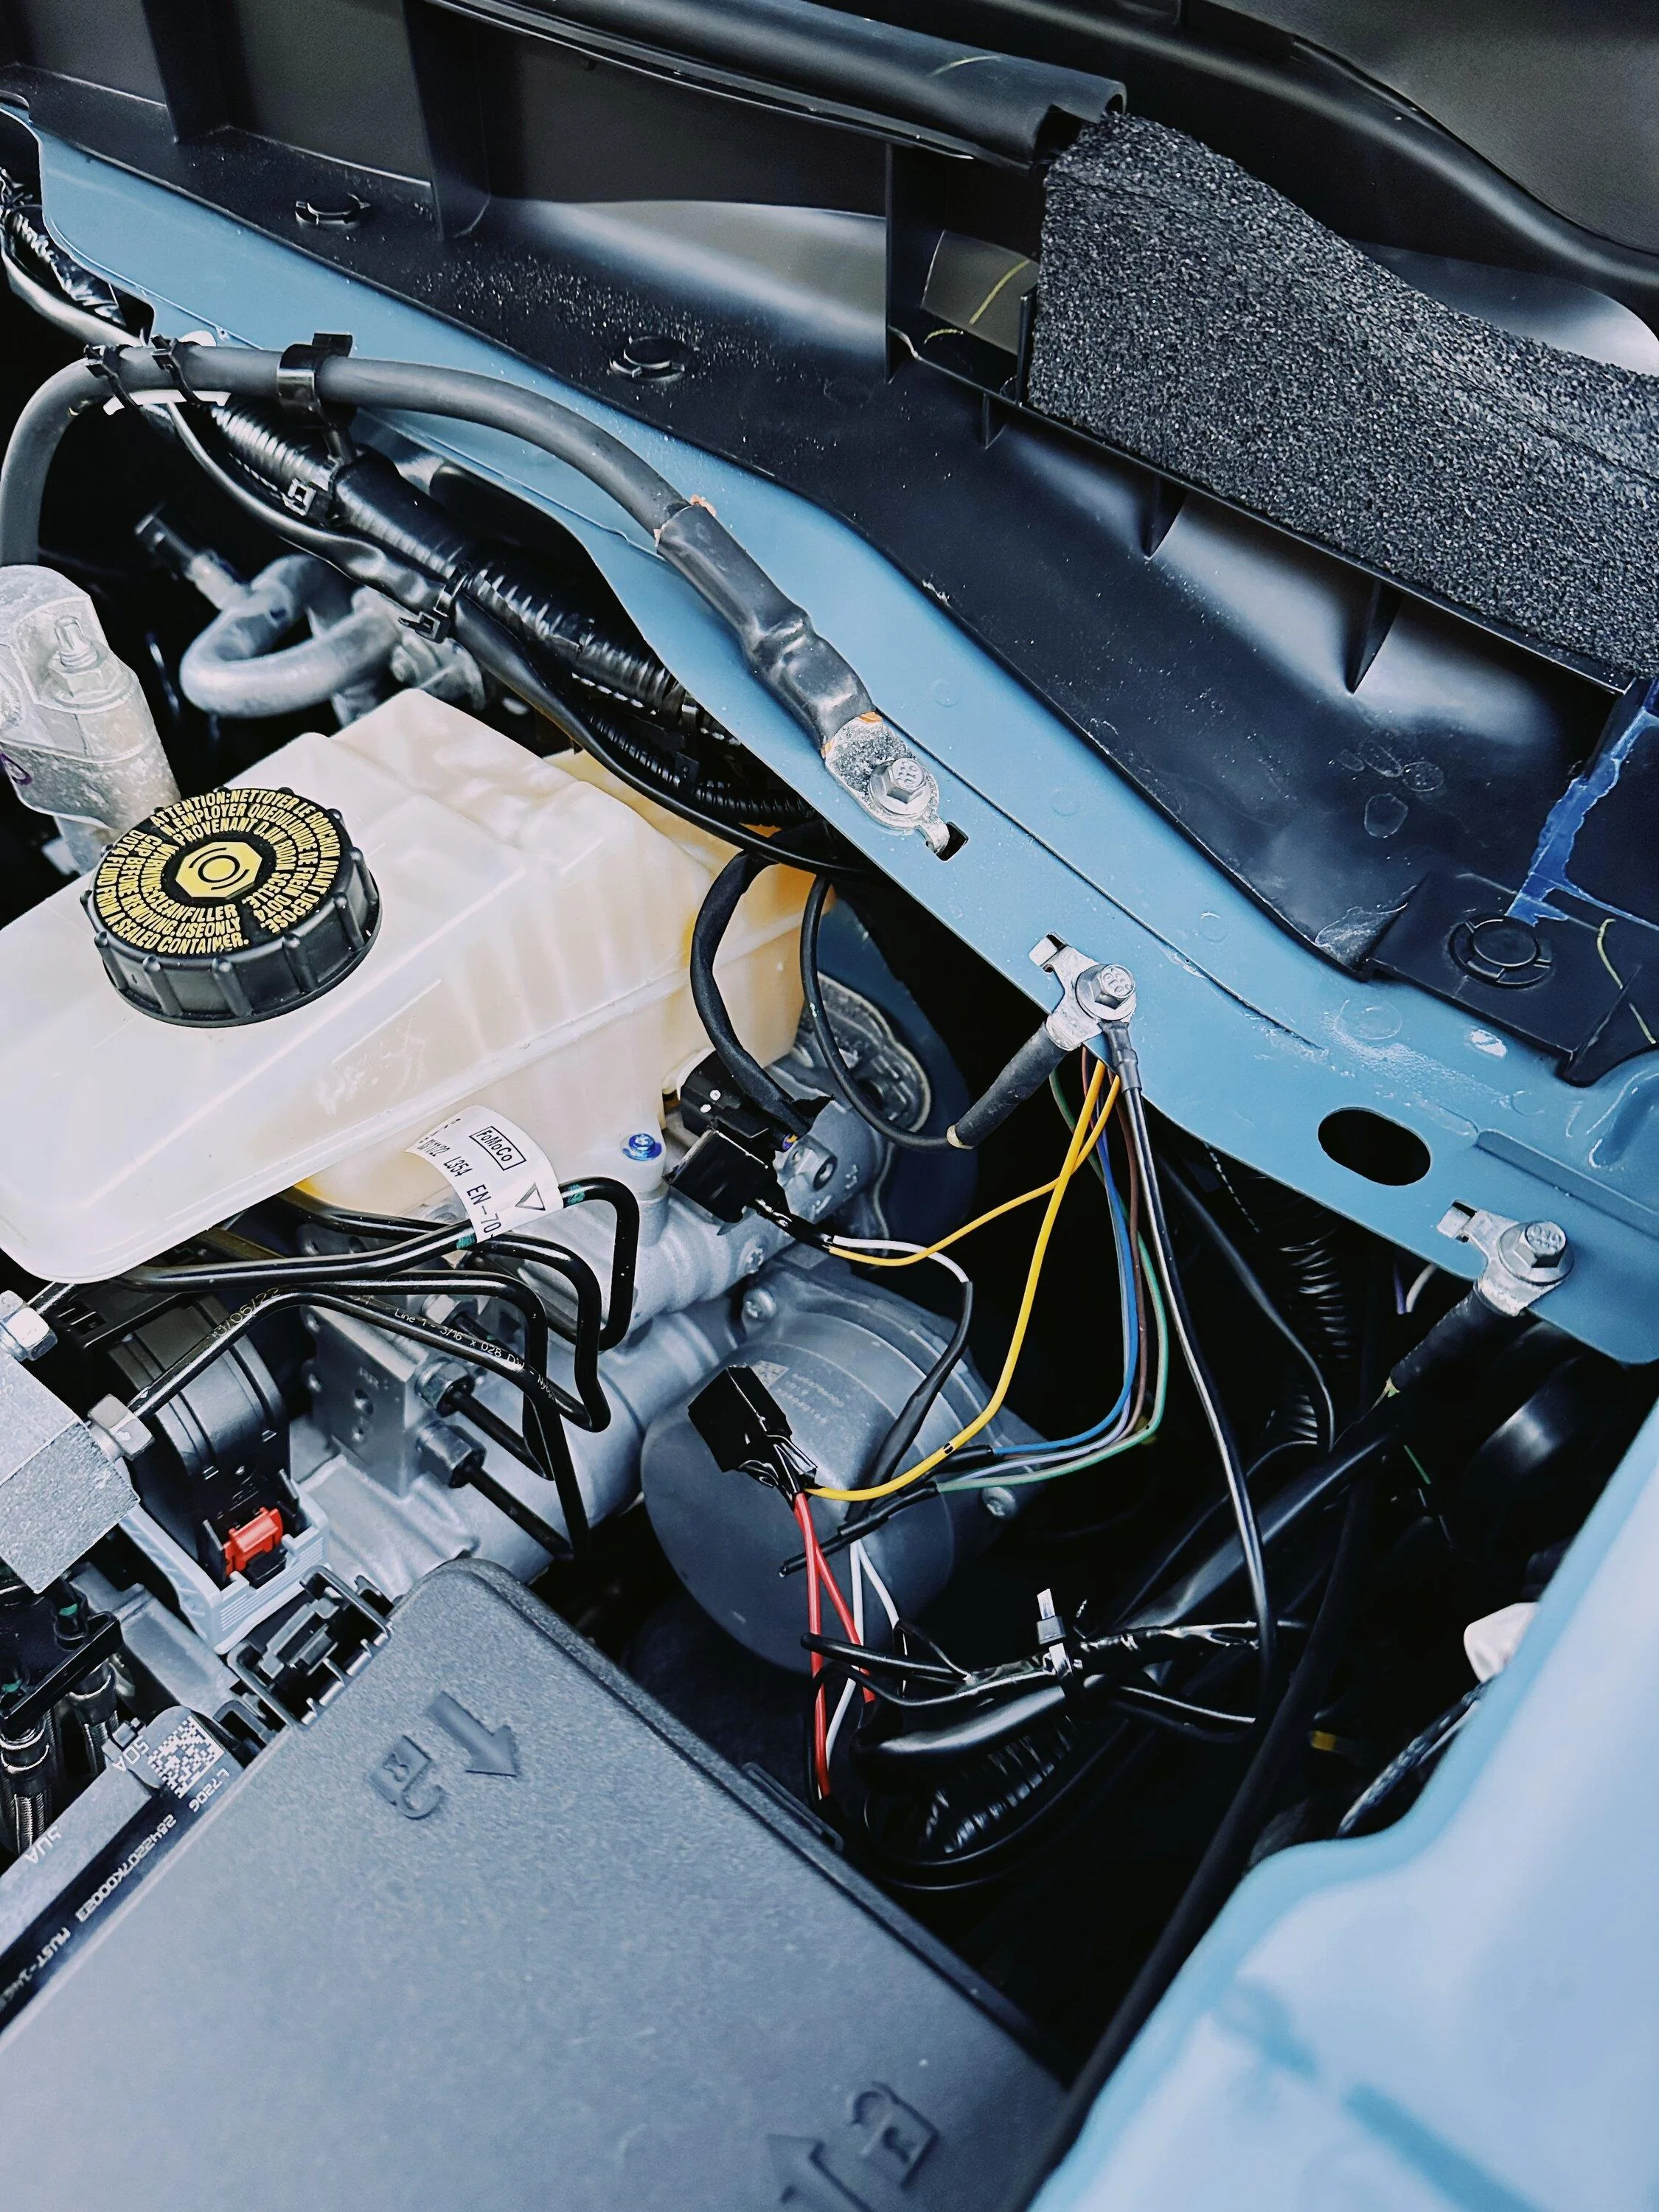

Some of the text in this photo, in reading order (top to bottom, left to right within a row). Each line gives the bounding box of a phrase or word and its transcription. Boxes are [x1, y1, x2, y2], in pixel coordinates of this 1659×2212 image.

[293, 802, 316, 818] LE
[133, 835, 163, 857] CAP
[172, 817, 259, 846] PROVENANT
[273, 839, 297, 871] BIDON
[305, 812, 340, 858] BOUCHON
[97, 856, 126, 886] FLUID
[298, 851, 319, 866] DE
[118, 856, 147, 898] BEFORE
[282, 867, 316, 897] FREIN
[308, 860, 339, 894] AVANT
[96, 886, 122, 917] FROM
[104, 912, 126, 926] A
[111, 918, 161, 950] SEALED
[476, 1130, 512, 1161] FoMoCo
[443, 1156, 473, 1177] L354
[394, 1308, 415, 1323] Line
